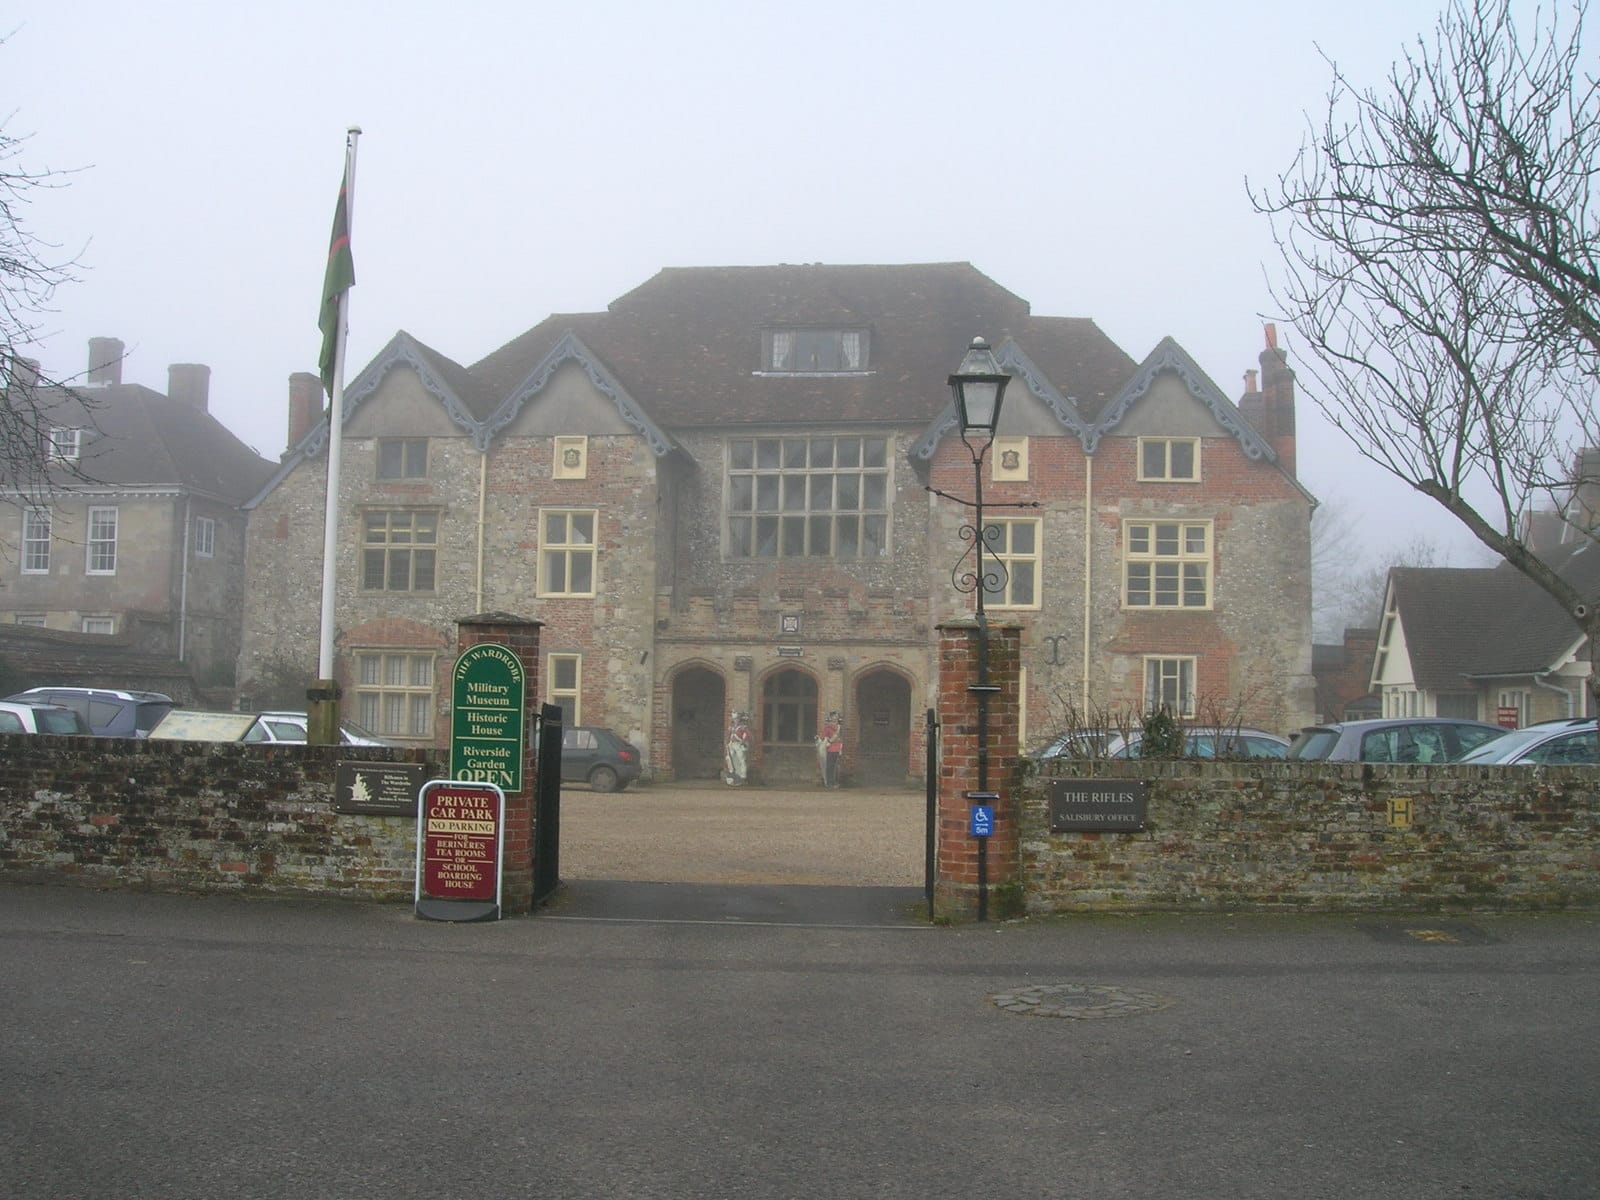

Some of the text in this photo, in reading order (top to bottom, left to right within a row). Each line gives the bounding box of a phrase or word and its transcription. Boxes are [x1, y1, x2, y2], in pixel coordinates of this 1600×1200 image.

[457, 650, 520, 683] THE WARDROBE
[468, 683, 509, 695] Military
[466, 695, 510, 706] Museum
[467, 712, 508, 724] Historic
[471, 725, 503, 736] House
[463, 746, 511, 758] Riverside
[467, 758, 506, 770] Garden
[457, 769, 514, 786] OPEN
[437, 796, 489, 808] PRIVATE
[1064, 792, 1134, 803] THE RIFLES
[430, 807, 493, 820] CAR PARK
[1060, 814, 1137, 822] SALISBURY OFFICE
[1392, 801, 1408, 824] H
[431, 821, 492, 831] NO PARKING
[436, 848, 487, 858] TEA ROOMS
[442, 863, 477, 872] SCHOOL
[438, 871, 483, 881] BOARDING
[445, 880, 475, 889] HOUSE
